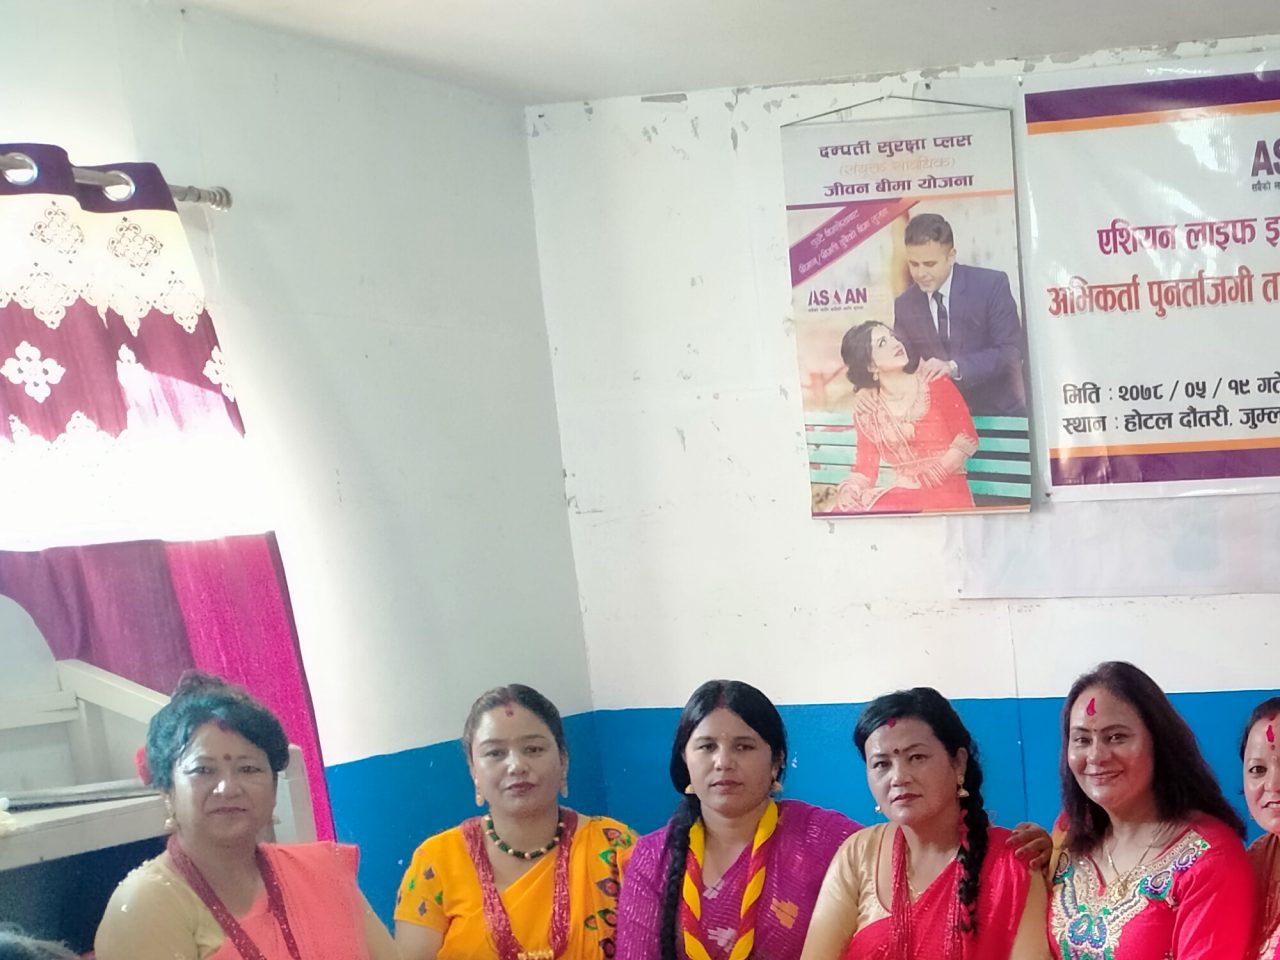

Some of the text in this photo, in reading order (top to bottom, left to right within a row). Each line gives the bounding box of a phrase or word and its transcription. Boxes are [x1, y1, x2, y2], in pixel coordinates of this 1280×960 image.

[818, 134, 973, 158] दम्पती सुरक्षा प्लस
[823, 174, 974, 197] जीवन बीमा योजना
[1097, 218, 1177, 255] एशियन
[1185, 217, 1258, 251] लाइफ
[1062, 381, 1101, 405] मिति
[1118, 383, 1164, 402] २०७८
[1184, 380, 1207, 400] ०५
[1062, 415, 1107, 435] स्थान
[1123, 408, 1174, 433] होटल
